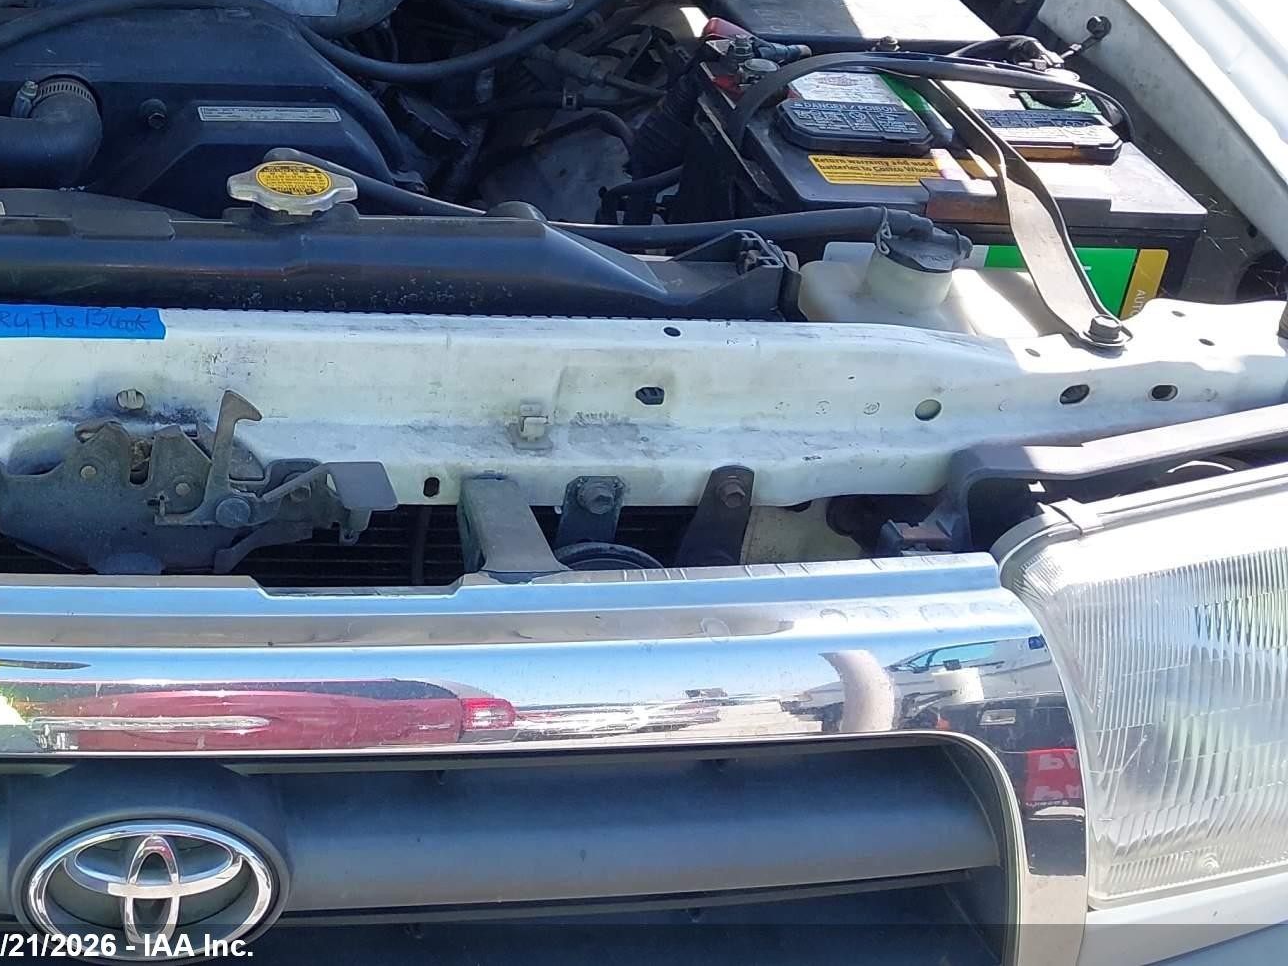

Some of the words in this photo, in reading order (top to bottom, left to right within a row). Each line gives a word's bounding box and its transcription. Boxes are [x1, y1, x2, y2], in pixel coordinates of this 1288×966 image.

[813, 157, 846, 165] Return
[847, 159, 890, 167] warranty
[819, 164, 859, 172] batteries
